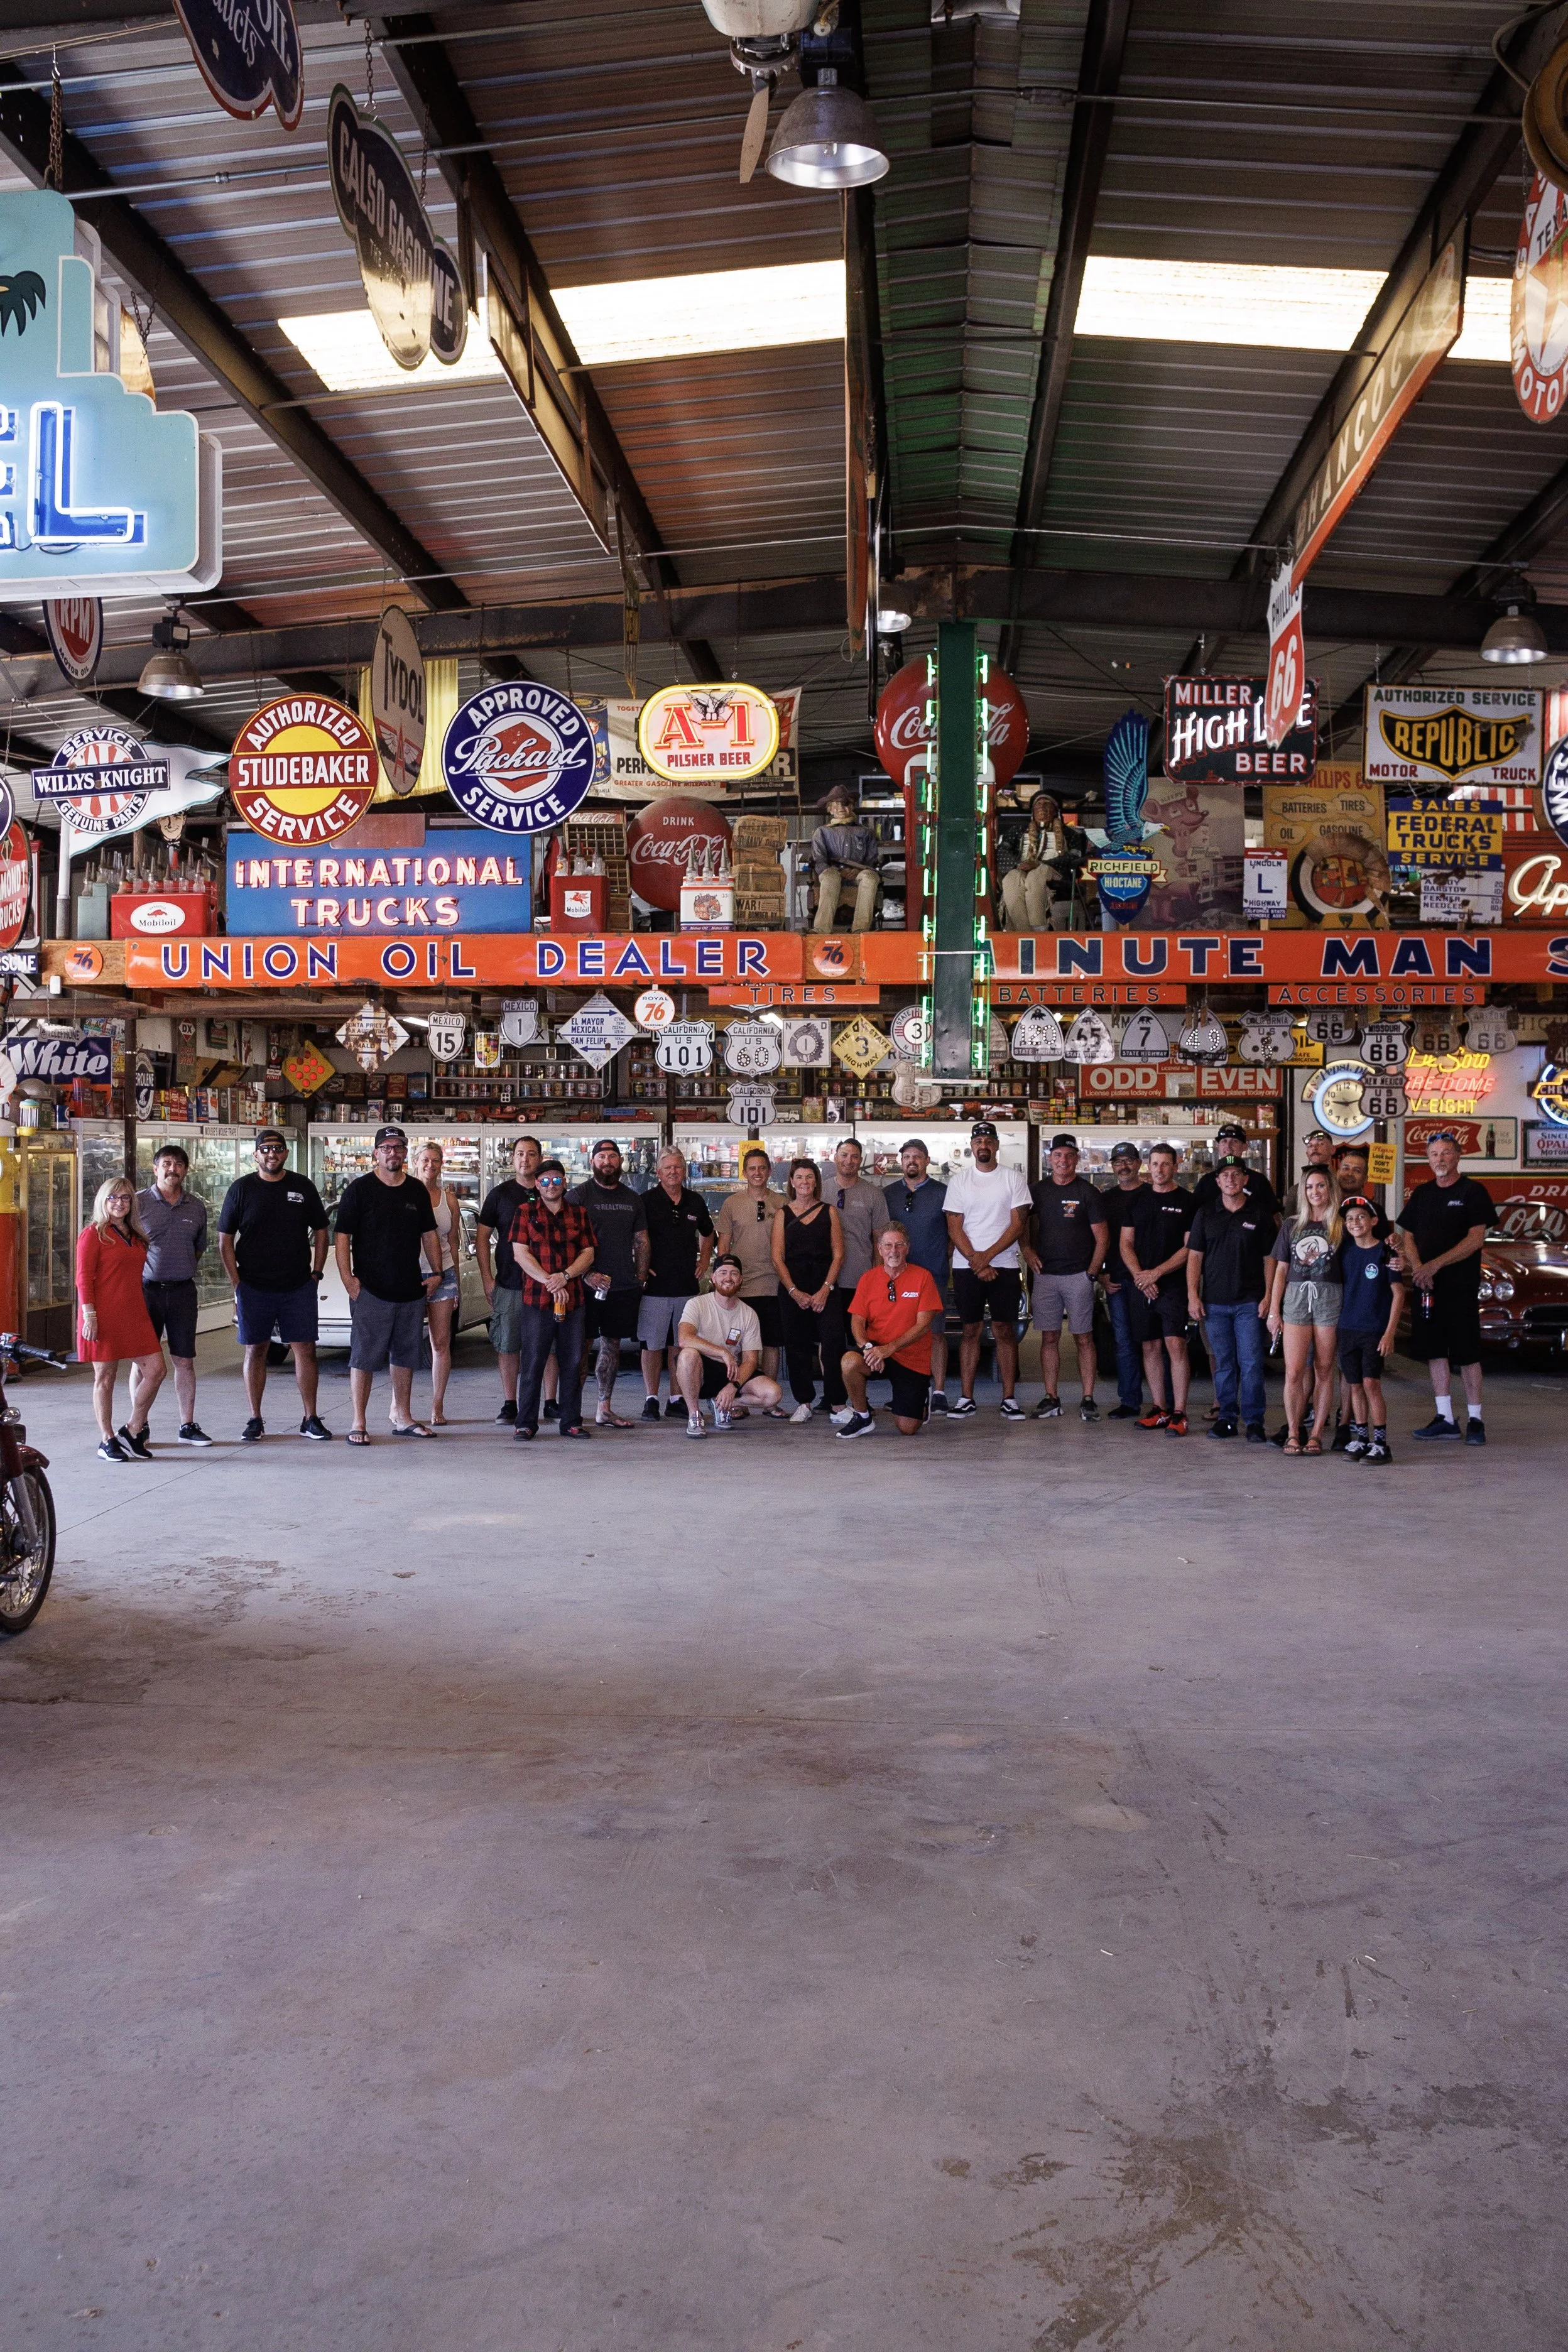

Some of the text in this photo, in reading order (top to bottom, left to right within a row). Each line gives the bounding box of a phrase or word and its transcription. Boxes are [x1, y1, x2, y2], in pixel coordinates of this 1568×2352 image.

[339, 120, 385, 239] CALSO
[388, 199, 455, 332] GASOLINE
[1307, 290, 1428, 533] HANCOCK
[60, 598, 90, 644] RPM
[80, 665, 90, 677] OIL
[381, 627, 425, 726] TYDOL
[1271, 634, 1298, 721] 66
[1174, 682, 1252, 706] MILLER
[1373, 689, 1537, 707] AUTHORIZED SERVICE
[467, 688, 580, 736] APPROVED
[246, 700, 361, 751] AUTHORIZED
[653, 701, 755, 750] A-1
[62, 730, 136, 758] SERVICE
[1168, 708, 1248, 768] HIGH
[1394, 716, 1515, 768] REPUBLIC
[448, 734, 589, 781] Packard
[667, 751, 752, 768] PILSNER BEER
[1235, 753, 1307, 775] BEER
[35, 766, 166, 794] WILLYS KNIGHT
[237, 755, 370, 787] STUDEBAKER
[1369, 763, 1537, 781] MOTOR TRUCK
[614, 779, 682, 788] GREATER GASOLINE
[462, 787, 565, 827] SERVICE
[1282, 801, 1327, 815] BATTERIES
[1340, 799, 1366, 812] TIRES
[1412, 798, 1481, 812] SALES
[60, 797, 144, 832] GENUINE PARTS
[246, 793, 361, 841] SERVICE
[662, 816, 694, 826] DRINK
[1395, 815, 1498, 834] FEDERAL
[1280, 827, 1295, 841] OIL
[1398, 833, 1492, 851] TRUCKS
[1090, 861, 1159, 873] RICHFIELD
[1249, 859, 1282, 868] LINCOLN
[1400, 852, 1489, 866] SERVICE
[235, 857, 523, 888] INTERNATIONAL
[1257, 873, 1273, 894] L
[290, 896, 459, 927] TRUCKS
[566, 905, 590, 913] Mobiloil
[139, 919, 177, 927] Mobiloil
[72, 950, 94, 972] 76
[160, 941, 338, 981] UNION
[380, 941, 476, 979] OIL
[535, 938, 771, 979] DEALER
[1320, 937, 1491, 977] MAN
[819, 944, 844, 966] 76
[749, 987, 836, 1003] TIRES
[998, 986, 1160, 1003] BATTERIES
[1278, 987, 1476, 1003] ACCESSORIES
[504, 1001, 535, 1011] MEXICO
[643, 1001, 665, 1022] 76
[182, 1024, 192, 1033] DX
[432, 1016, 461, 1026] MEXICO
[517, 1018, 523, 1036] 1
[571, 1018, 579, 1026] EL
[581, 1018, 605, 1026] MAYOR
[571, 1025, 603, 1034] MEXICALI
[663, 1025, 705, 1034] CALIFORNIA
[1368, 1024, 1401, 1033] MISSOURI
[732, 1026, 775, 1035] CALIFORNIA
[1019, 1024, 1057, 1047] 120
[1076, 1027, 1102, 1047] 65
[1139, 1026, 1151, 1048] 7
[1316, 1021, 1343, 1040] 66
[436, 1032, 456, 1054] 15
[570, 1037, 584, 1045] SAN
[586, 1037, 607, 1045] FELIPE
[835, 1032, 851, 1048] THE
[854, 1035, 869, 1057] 3
[1422, 1033, 1451, 1051] 66
[1477, 1032, 1507, 1051] 66
[8, 1039, 109, 1075] White
[665, 1045, 704, 1067] 101
[736, 1046, 770, 1067] 60
[844, 1052, 879, 1069] HIGHWAY
[1369, 1043, 1398, 1062] 66
[1089, 1067, 1158, 1091] ODD
[1200, 1067, 1278, 1091] EVEN
[1343, 1082, 1351, 1090] 12
[1364, 1077, 1404, 1086] NEW MEXICO
[1440, 1077, 1496, 1092] DOME
[1111, 1090, 1130, 1098] plates
[1200, 1089, 1279, 1098] License plates today only
[1327, 1091, 1336, 1099] 10
[1328, 1108, 1333, 1116] 8
[1369, 1097, 1398, 1115] 66
[1410, 1097, 1478, 1114] V-EIGHT
[740, 1106, 767, 1124] 101
[1343, 1118, 1349, 1126] 6
[1353, 1116, 1358, 1124] 5
[601, 1203, 634, 1212] REALTRUCK
